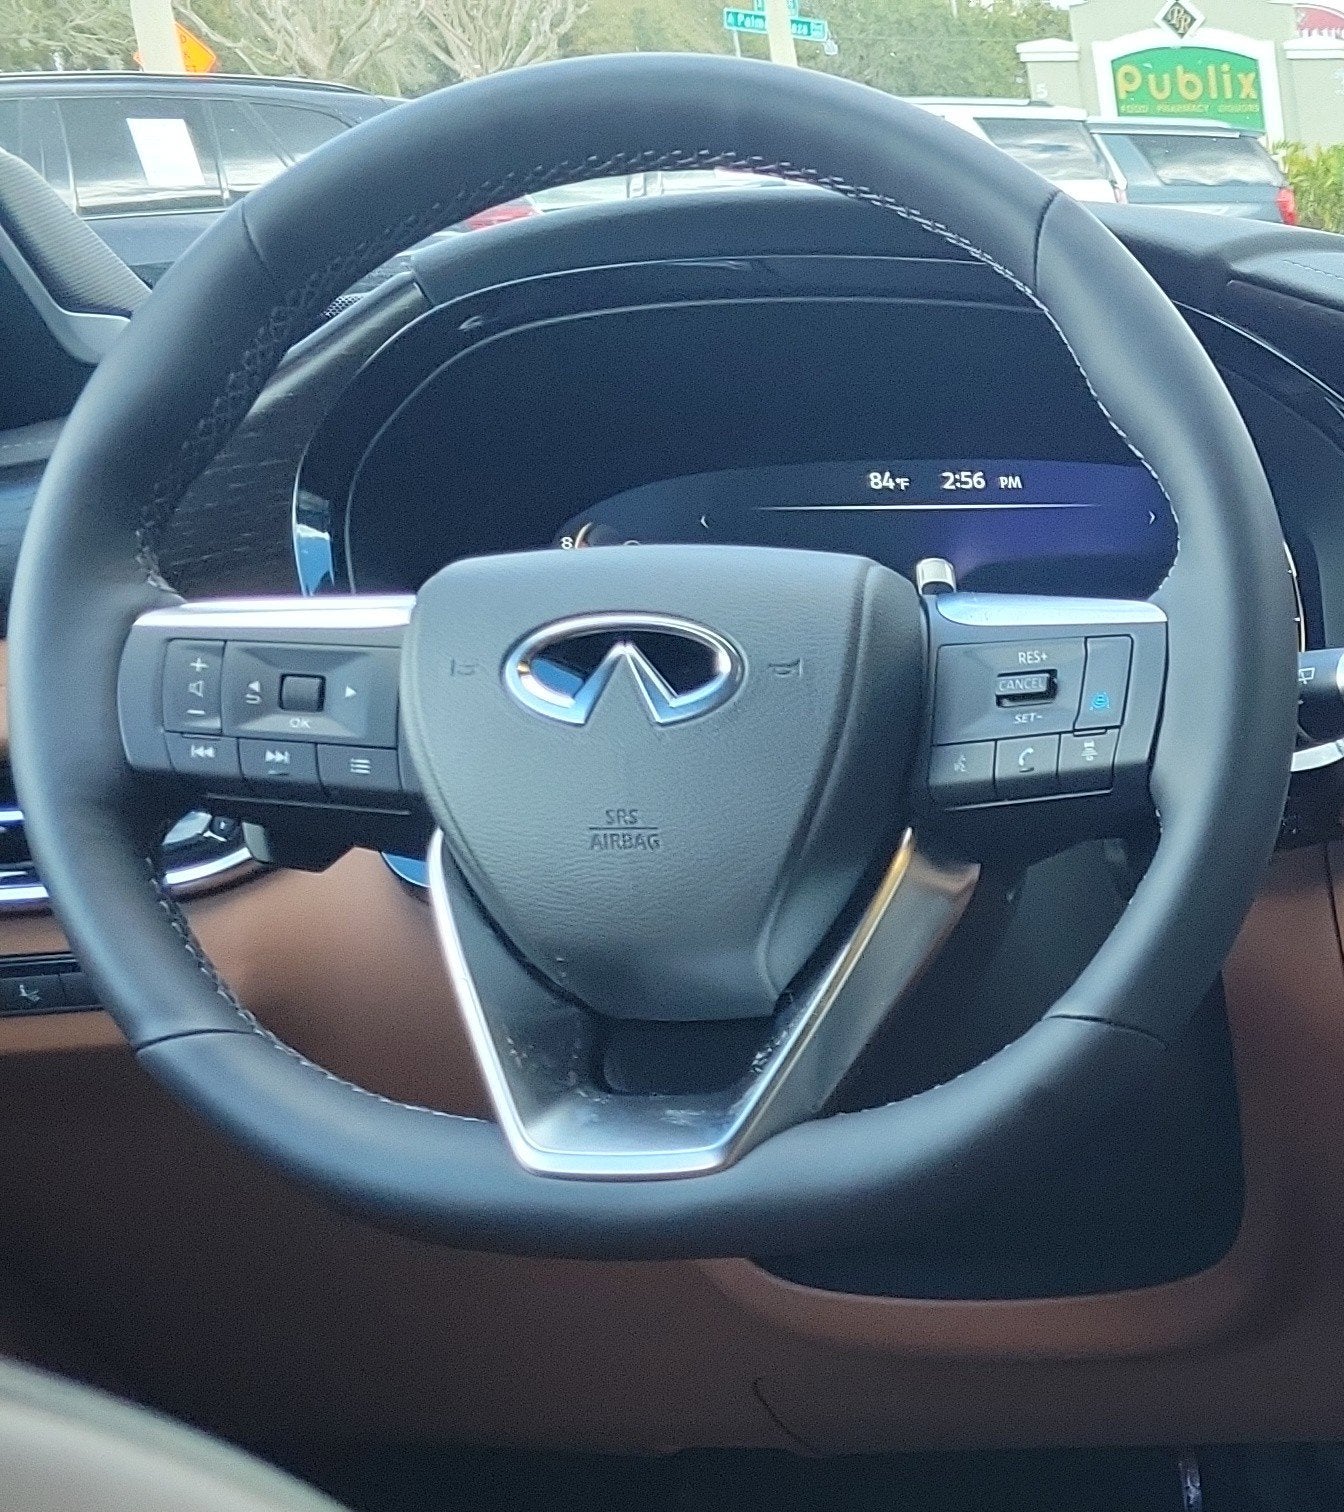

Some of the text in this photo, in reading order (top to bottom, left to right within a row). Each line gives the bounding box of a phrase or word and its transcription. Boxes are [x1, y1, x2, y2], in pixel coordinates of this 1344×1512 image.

[1116, 62, 1258, 101] Publix
[1120, 103, 1148, 113] FOOD
[1157, 103, 1209, 113] PHARMACY
[941, 471, 986, 490] 2:56
[999, 475, 1023, 489] PM
[561, 536, 574, 550] 8
[1018, 650, 1048, 664] RES+
[999, 677, 1044, 691] CANCEL
[289, 718, 311, 729] OK
[605, 808, 639, 825] SRS
[589, 832, 661, 851] AIRBAG
